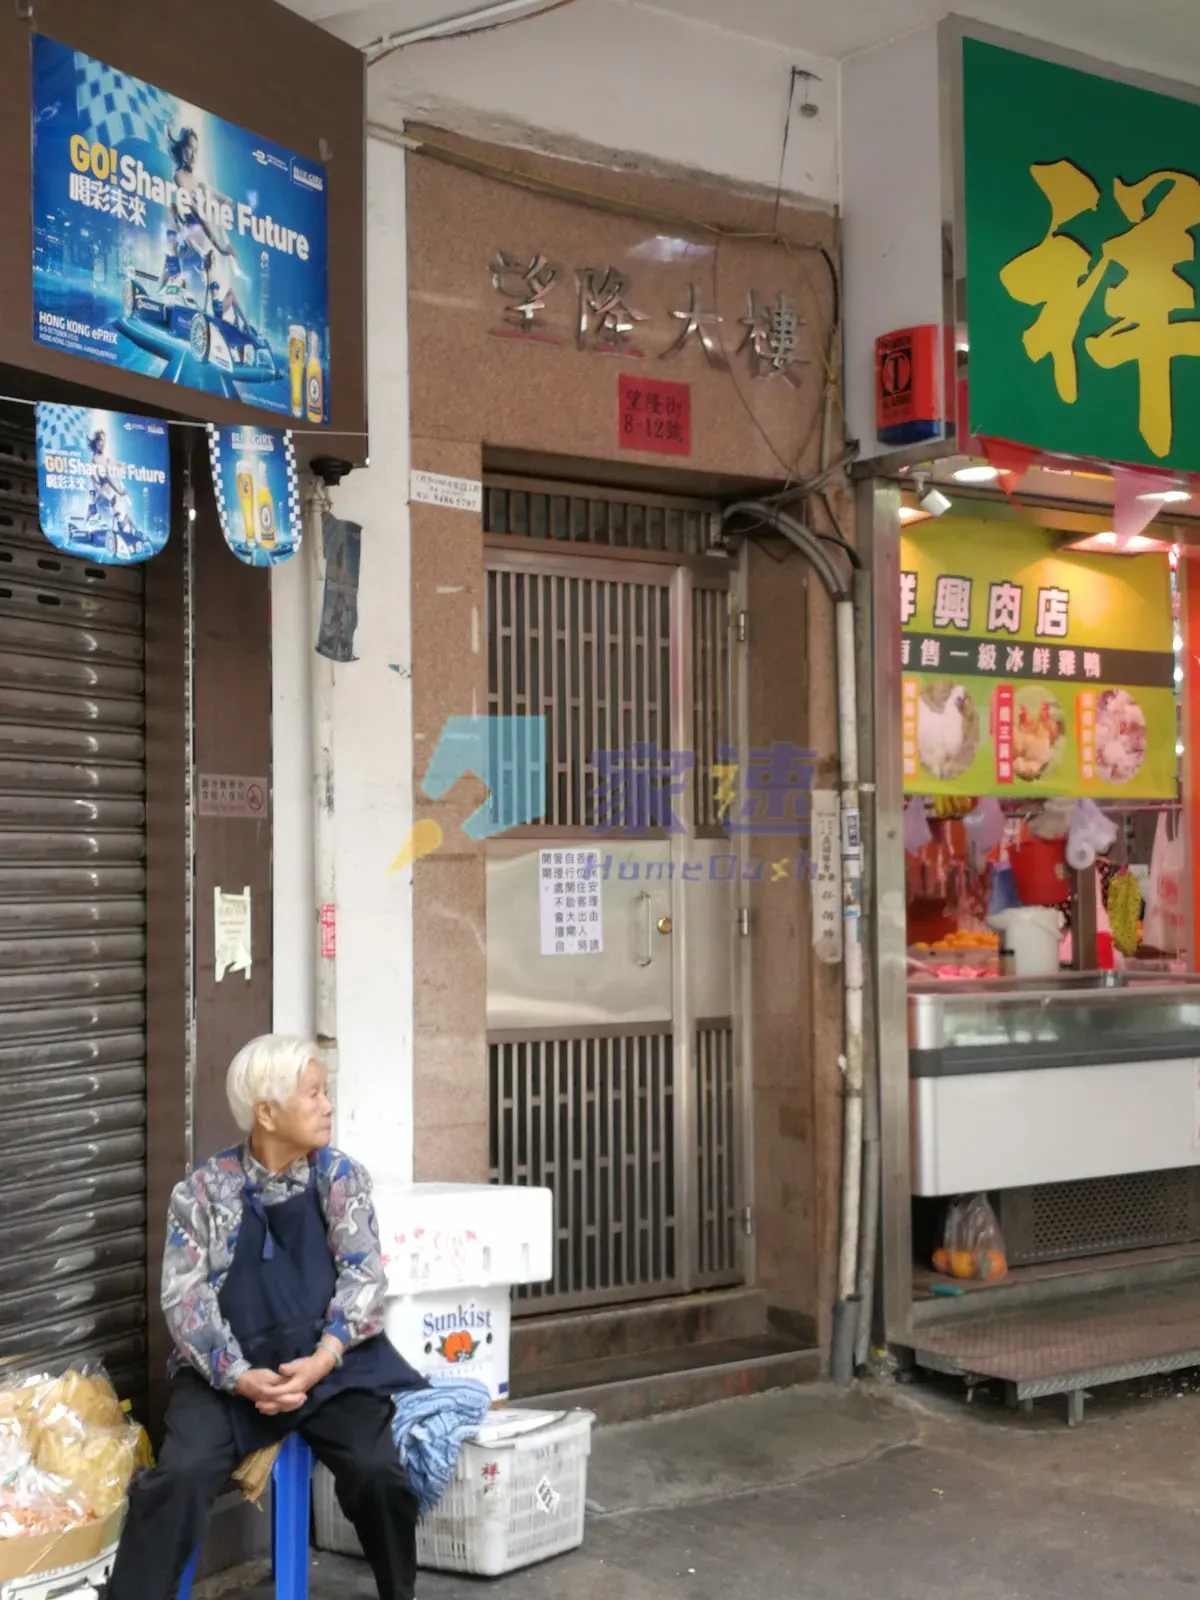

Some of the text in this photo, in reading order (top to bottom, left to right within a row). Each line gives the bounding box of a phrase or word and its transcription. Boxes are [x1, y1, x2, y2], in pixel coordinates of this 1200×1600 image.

[69, 134, 310, 261] GO! Share the Future
[69, 172, 146, 228] 喝彩未來
[487, 250, 811, 389] 望隆大樓
[1000, 158, 1200, 458] 祥
[39, 311, 118, 345] HONG KONG ePRIX
[626, 389, 682, 418] 望隆街
[624, 413, 683, 442] 8-12號
[45, 455, 67, 474] GO!
[68, 457, 107, 477] Share
[128, 463, 166, 485] Future
[423, 1304, 492, 1337] Sunkist
